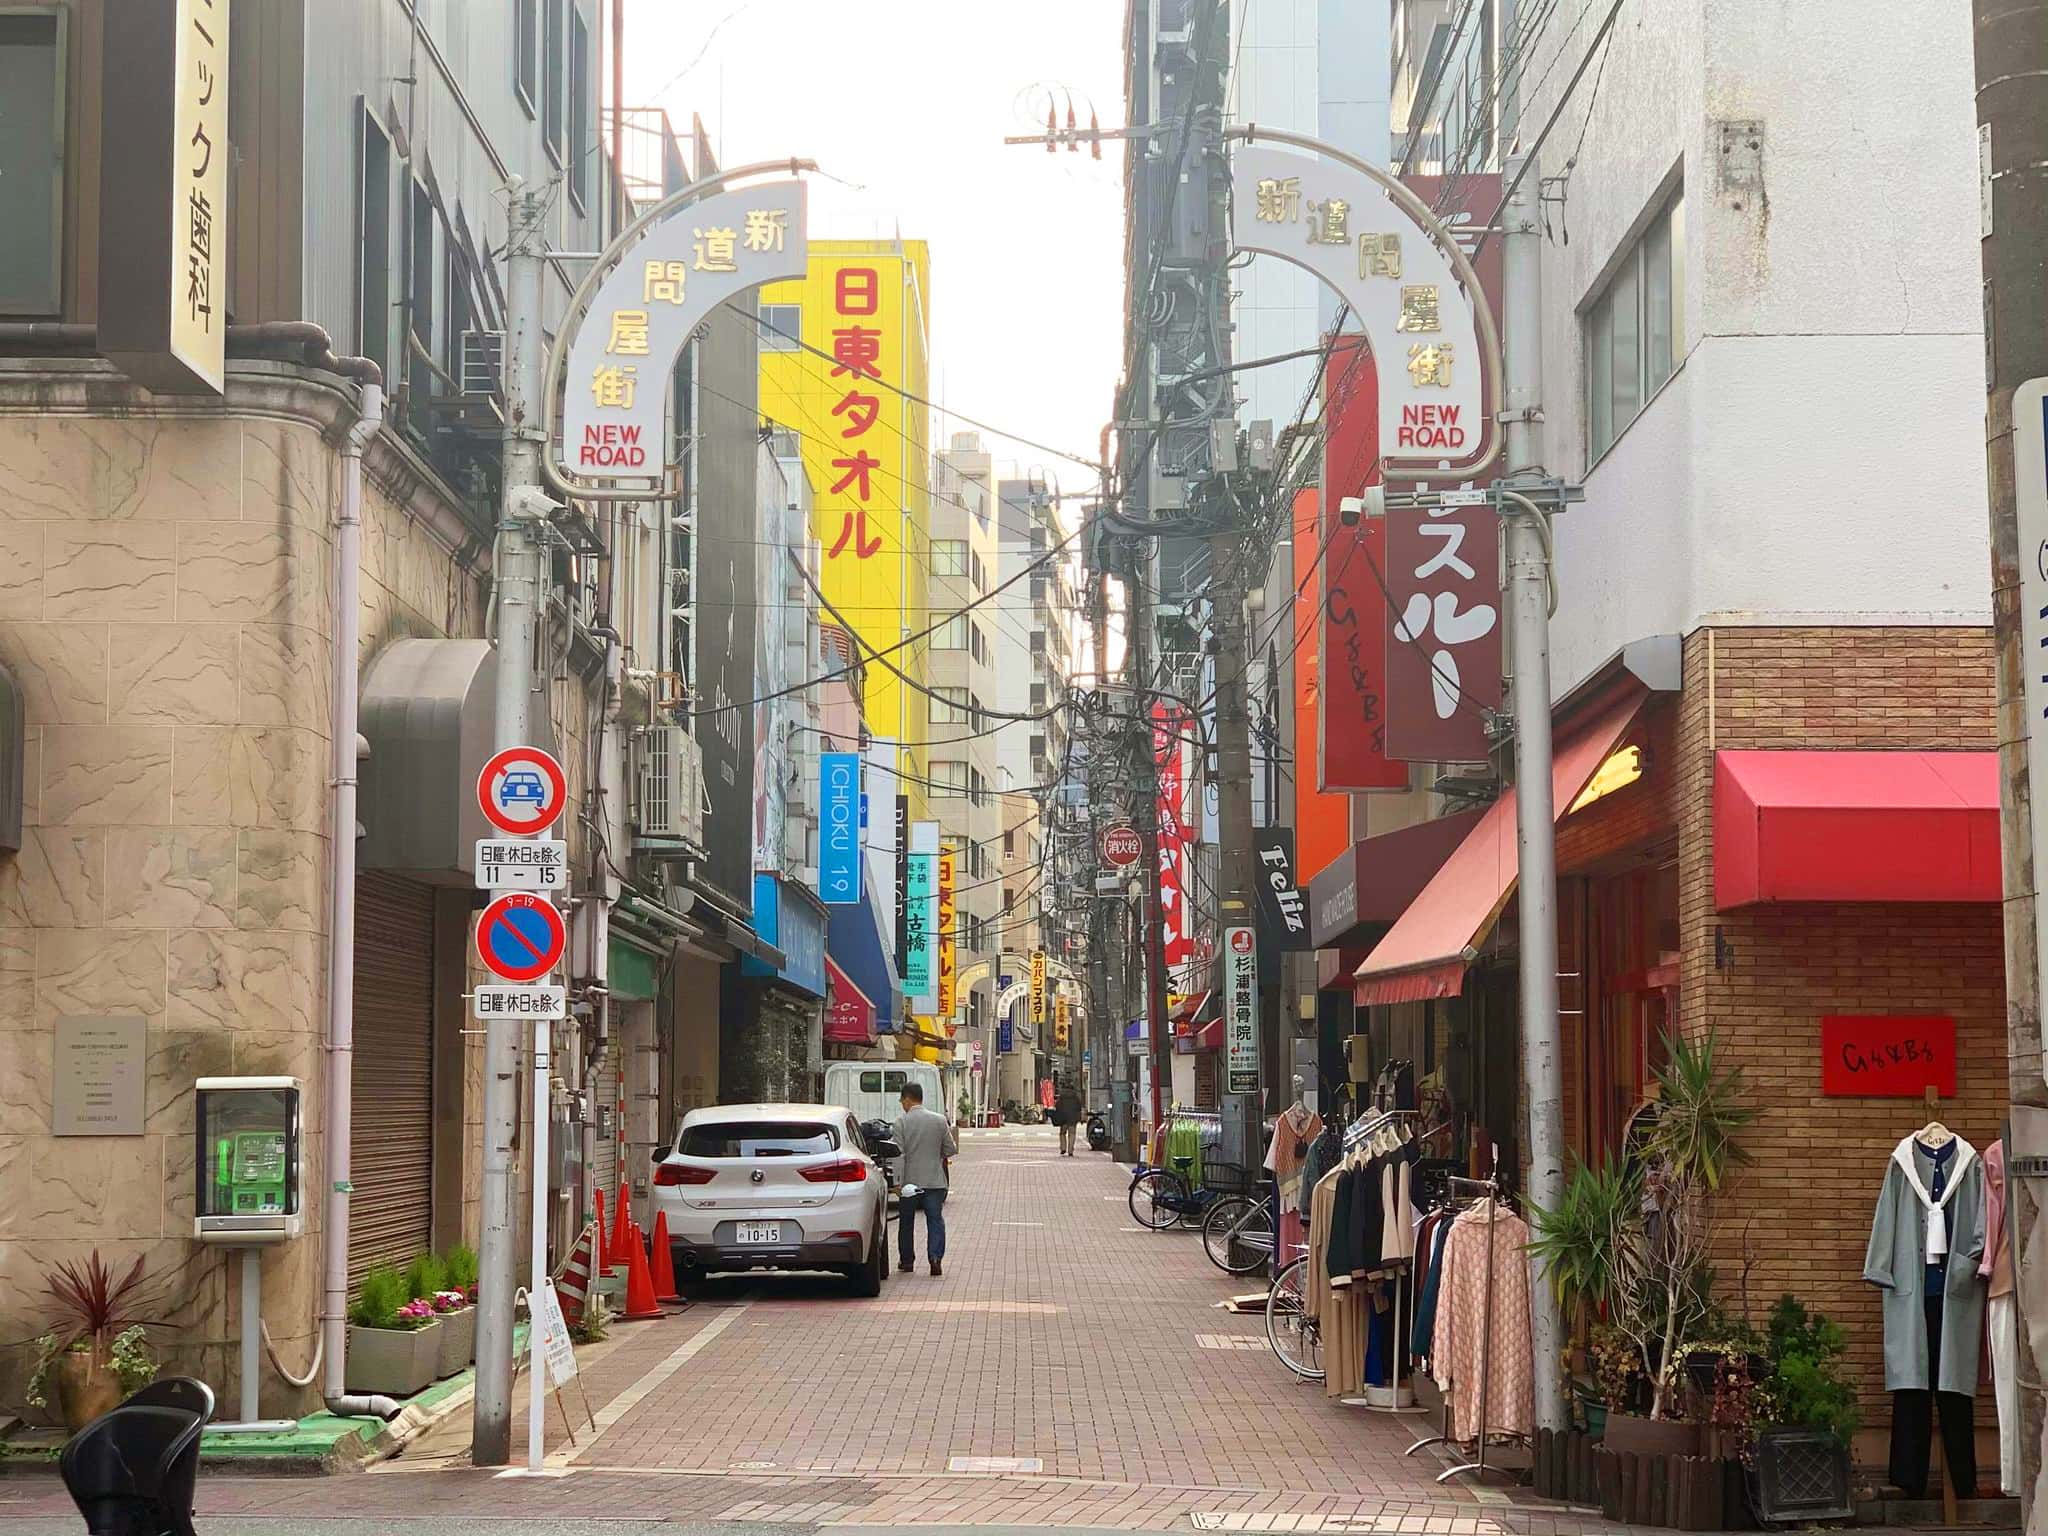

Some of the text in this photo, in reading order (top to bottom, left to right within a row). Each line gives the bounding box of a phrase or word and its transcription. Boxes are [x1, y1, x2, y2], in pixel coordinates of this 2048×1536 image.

[591, 208, 788, 410] 新道問屋街
[1256, 177, 1455, 388] 新道問屋街
[585, 424, 642, 444] NEW
[829, 267, 882, 560] 日東タオル
[1398, 426, 1465, 448] ROAD
[1402, 404, 1461, 426] NEW
[579, 445, 646, 466] ROAD
[1393, 505, 1498, 720] スルー
[715, 664, 741, 772] ebony
[831, 763, 850, 892] ICHIOKU 19
[1107, 839, 1139, 855] 消火栓
[486, 866, 499, 883] 11
[539, 866, 556, 883] 15
[507, 896, 535, 907] 9-19
[1260, 844, 1304, 933] Feliz
[907, 913, 926, 953] 古橋
[1235, 957, 1251, 1041] 杉浦整骨院
